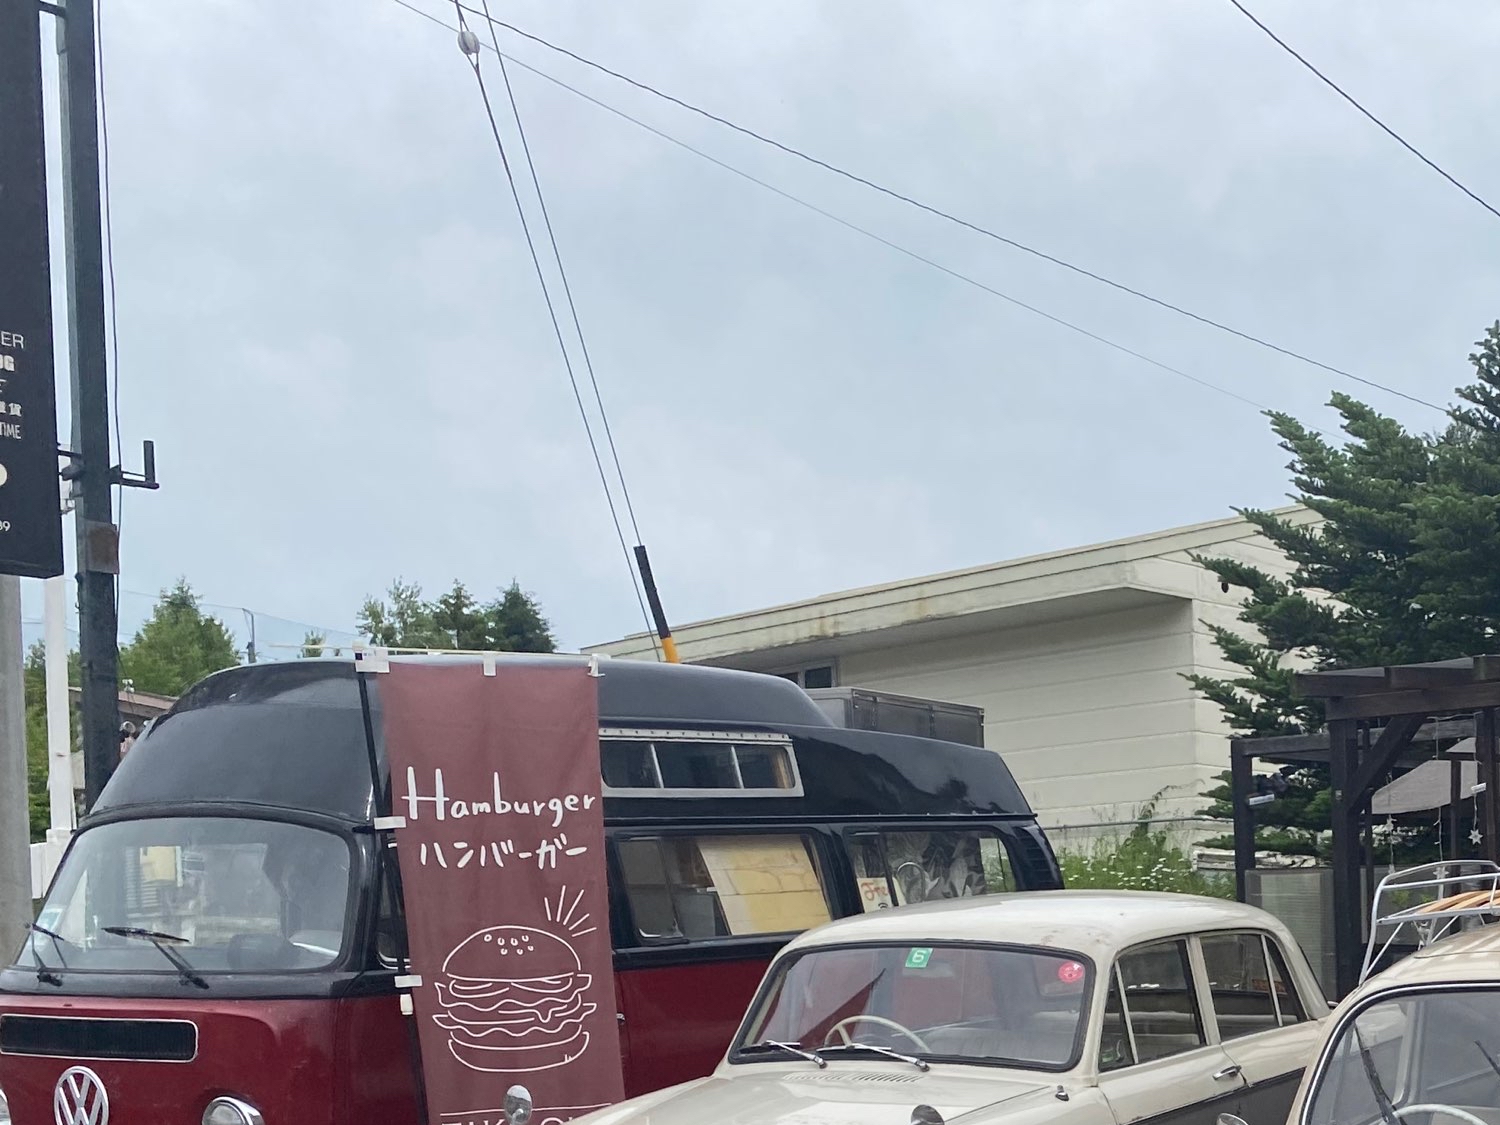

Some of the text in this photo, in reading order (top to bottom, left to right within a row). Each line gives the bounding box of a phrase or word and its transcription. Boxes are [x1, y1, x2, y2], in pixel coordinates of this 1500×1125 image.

[401, 766, 596, 827] Hamburger
[420, 833, 587, 869] ハンバーガー
